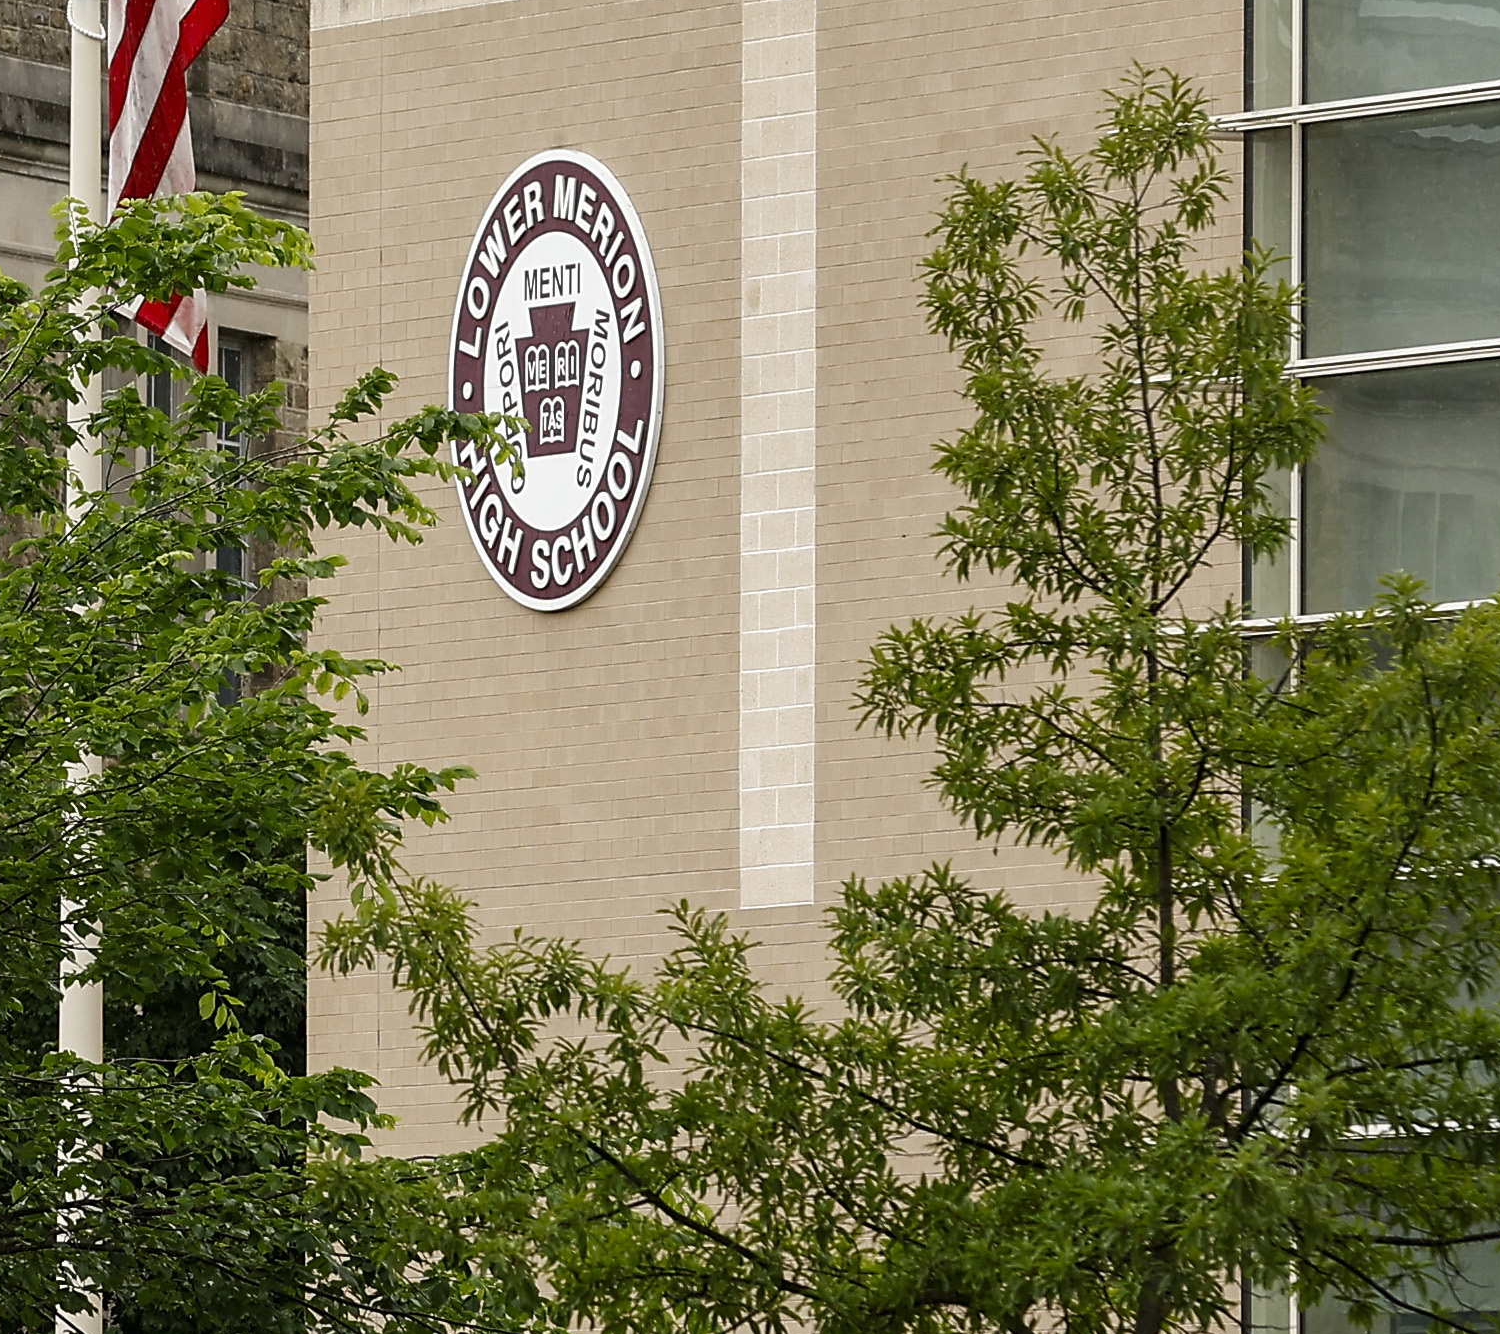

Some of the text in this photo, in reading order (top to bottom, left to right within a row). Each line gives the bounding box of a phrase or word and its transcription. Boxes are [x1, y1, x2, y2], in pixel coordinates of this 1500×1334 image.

[458, 173, 647, 358] LOWER MERION
[523, 262, 581, 302] MENTI
[576, 308, 611, 490] MORIBUS
[459, 419, 646, 590] HIGH SCHOOL
